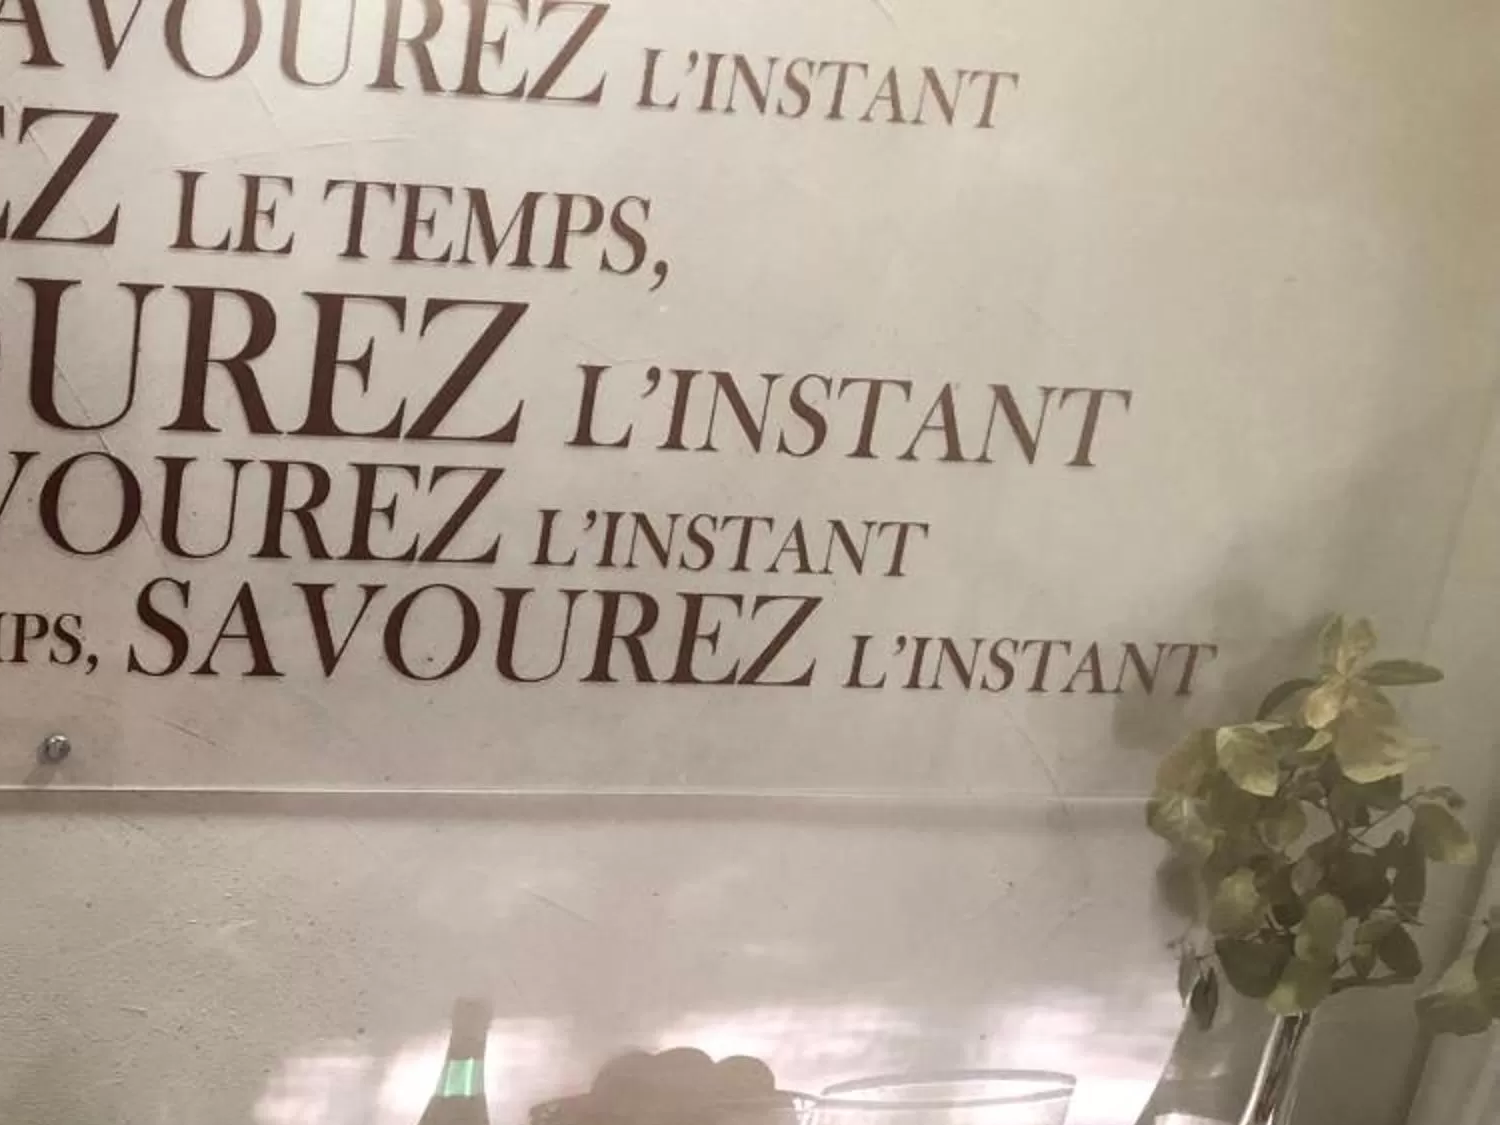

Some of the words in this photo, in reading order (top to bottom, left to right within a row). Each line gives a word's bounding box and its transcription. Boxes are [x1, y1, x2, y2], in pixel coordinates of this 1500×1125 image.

[636, 47, 1019, 130] L'INSTANT
[171, 170, 294, 255] LE
[324, 178, 671, 293] TEMPS,
[565, 363, 1132, 468] L'INSTANT
[532, 508, 930, 577] L'INSTANT
[128, 577, 823, 687] SAVOUREZ
[842, 633, 1218, 698] L'INSTANT
